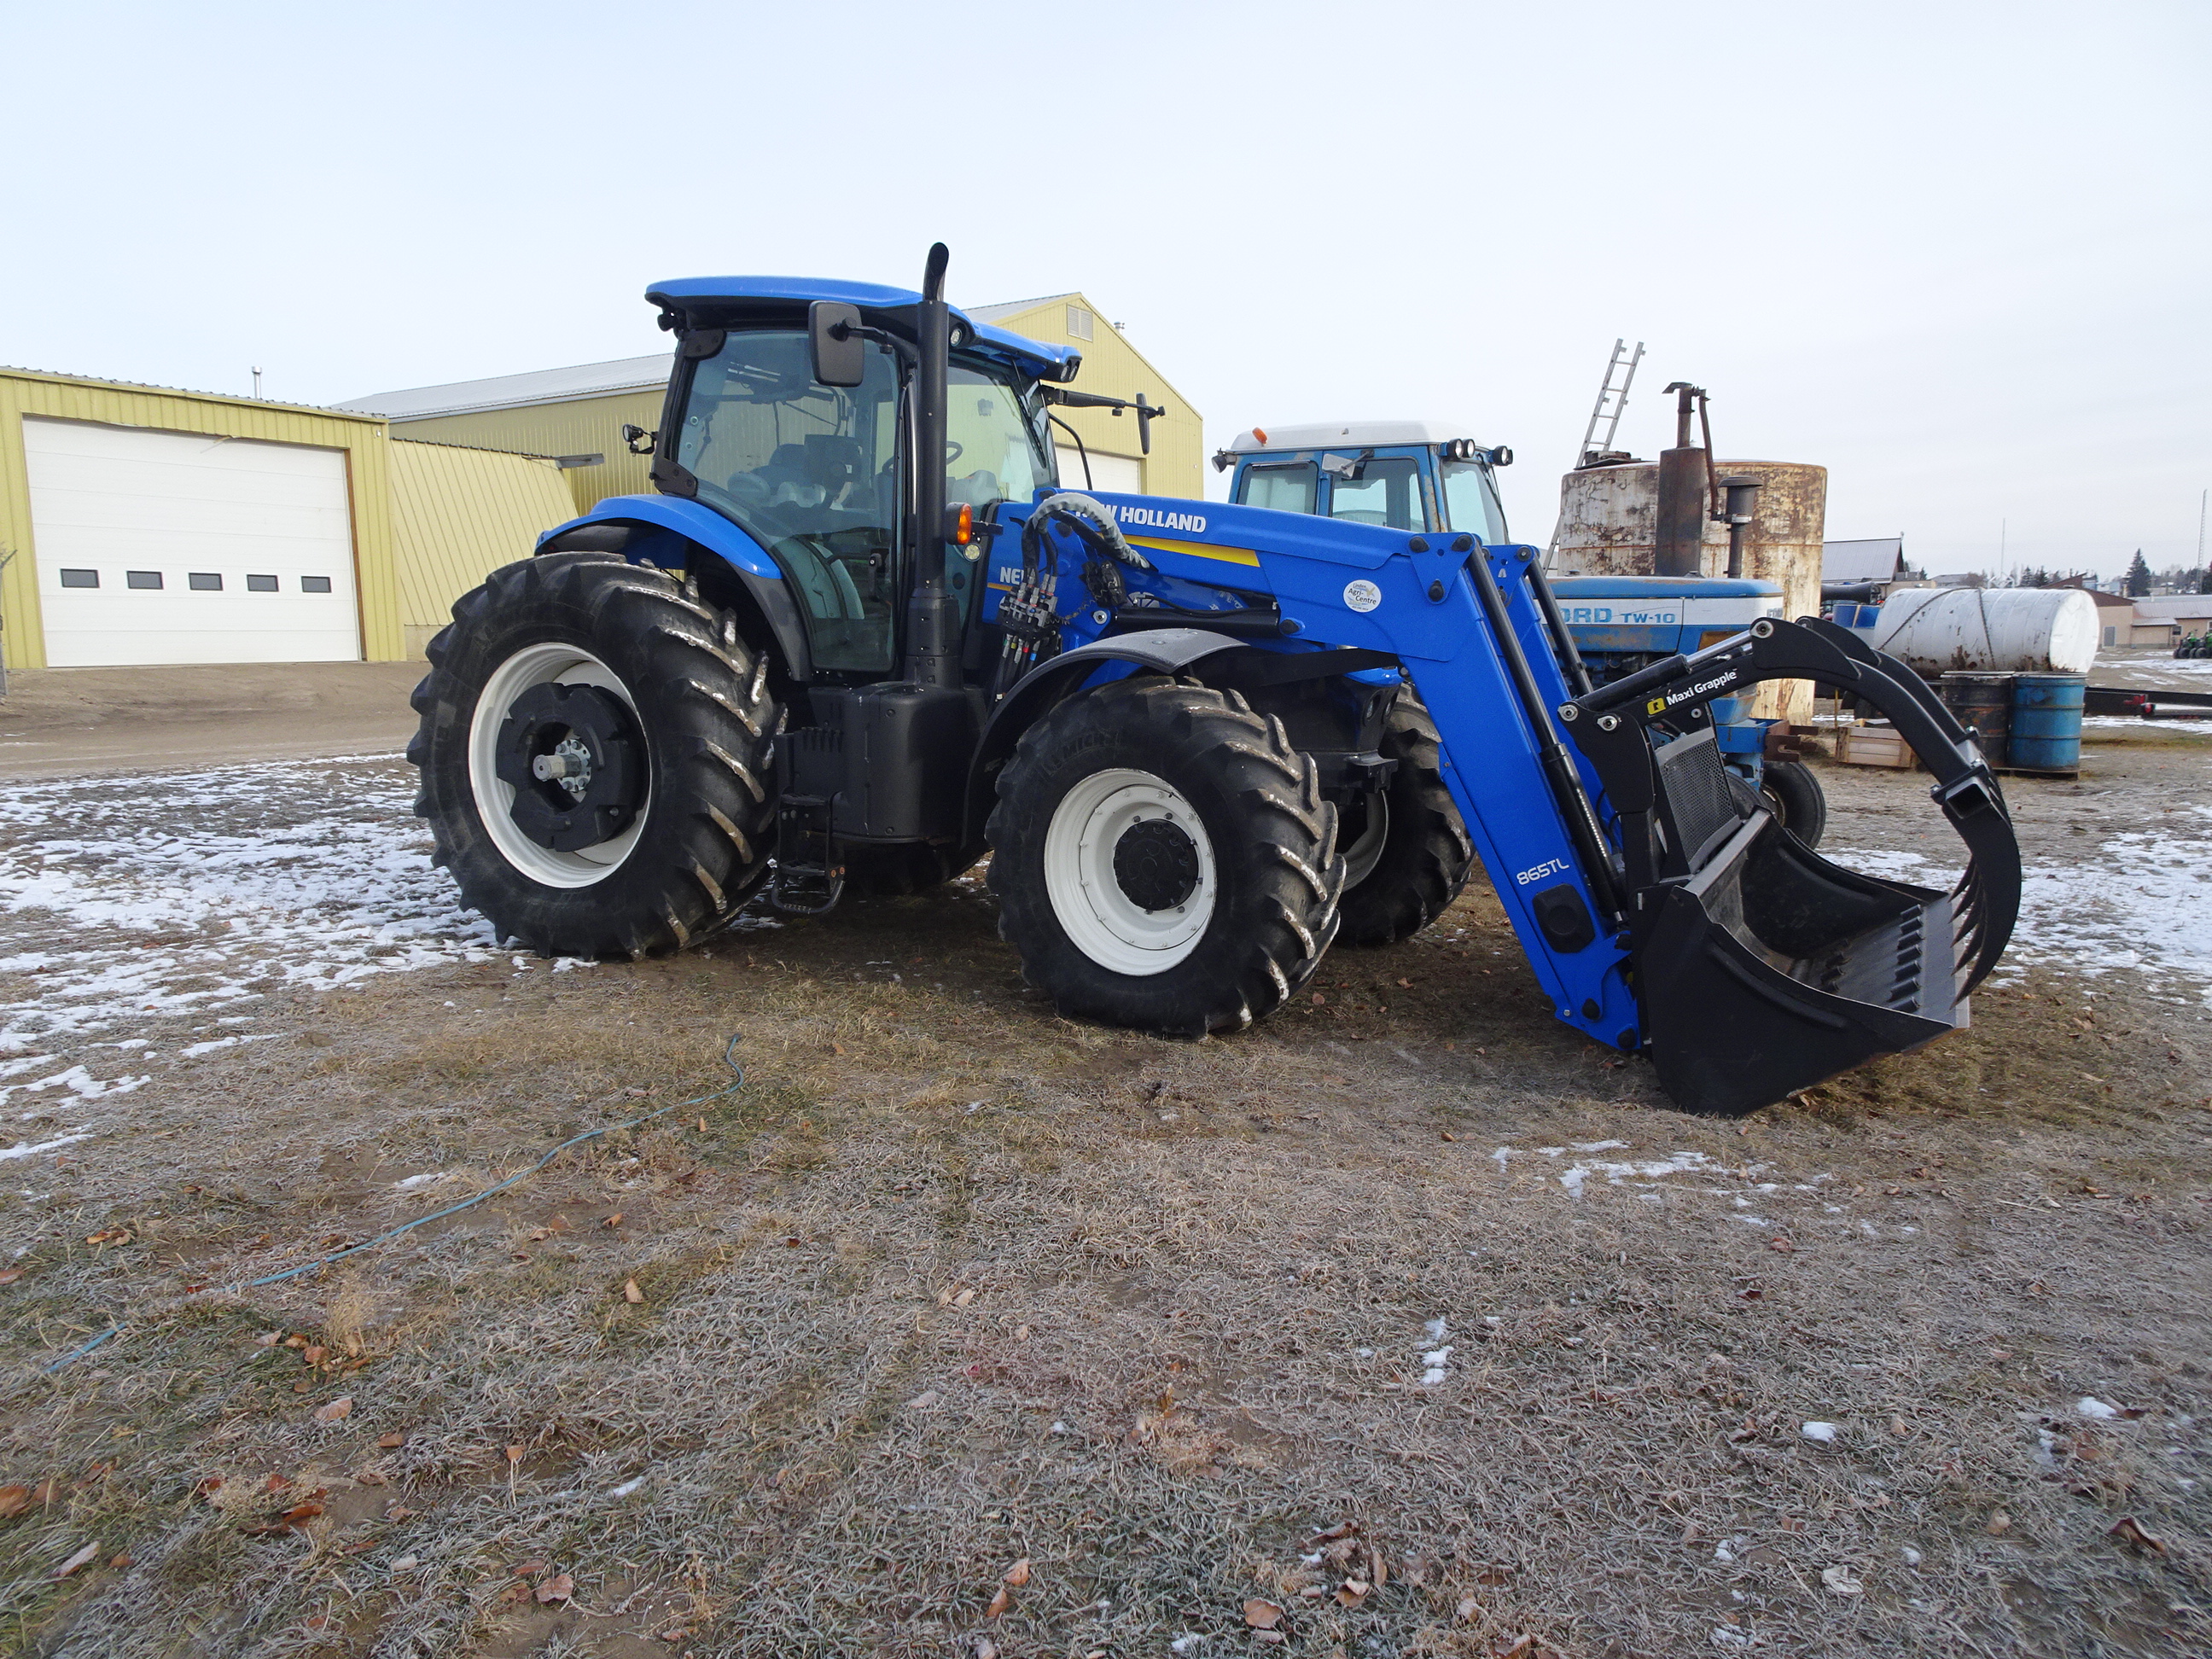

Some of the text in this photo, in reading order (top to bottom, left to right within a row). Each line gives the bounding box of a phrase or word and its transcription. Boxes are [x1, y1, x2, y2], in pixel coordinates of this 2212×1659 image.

[1121, 506, 1207, 533] HOLLAND
[999, 567, 1025, 585] NE
[1355, 596, 1377, 605] Centre
[1559, 608, 1676, 624] ORD TW-10
[1666, 671, 1738, 706] Maxi Grapple
[1516, 858, 1570, 886] 865TL
